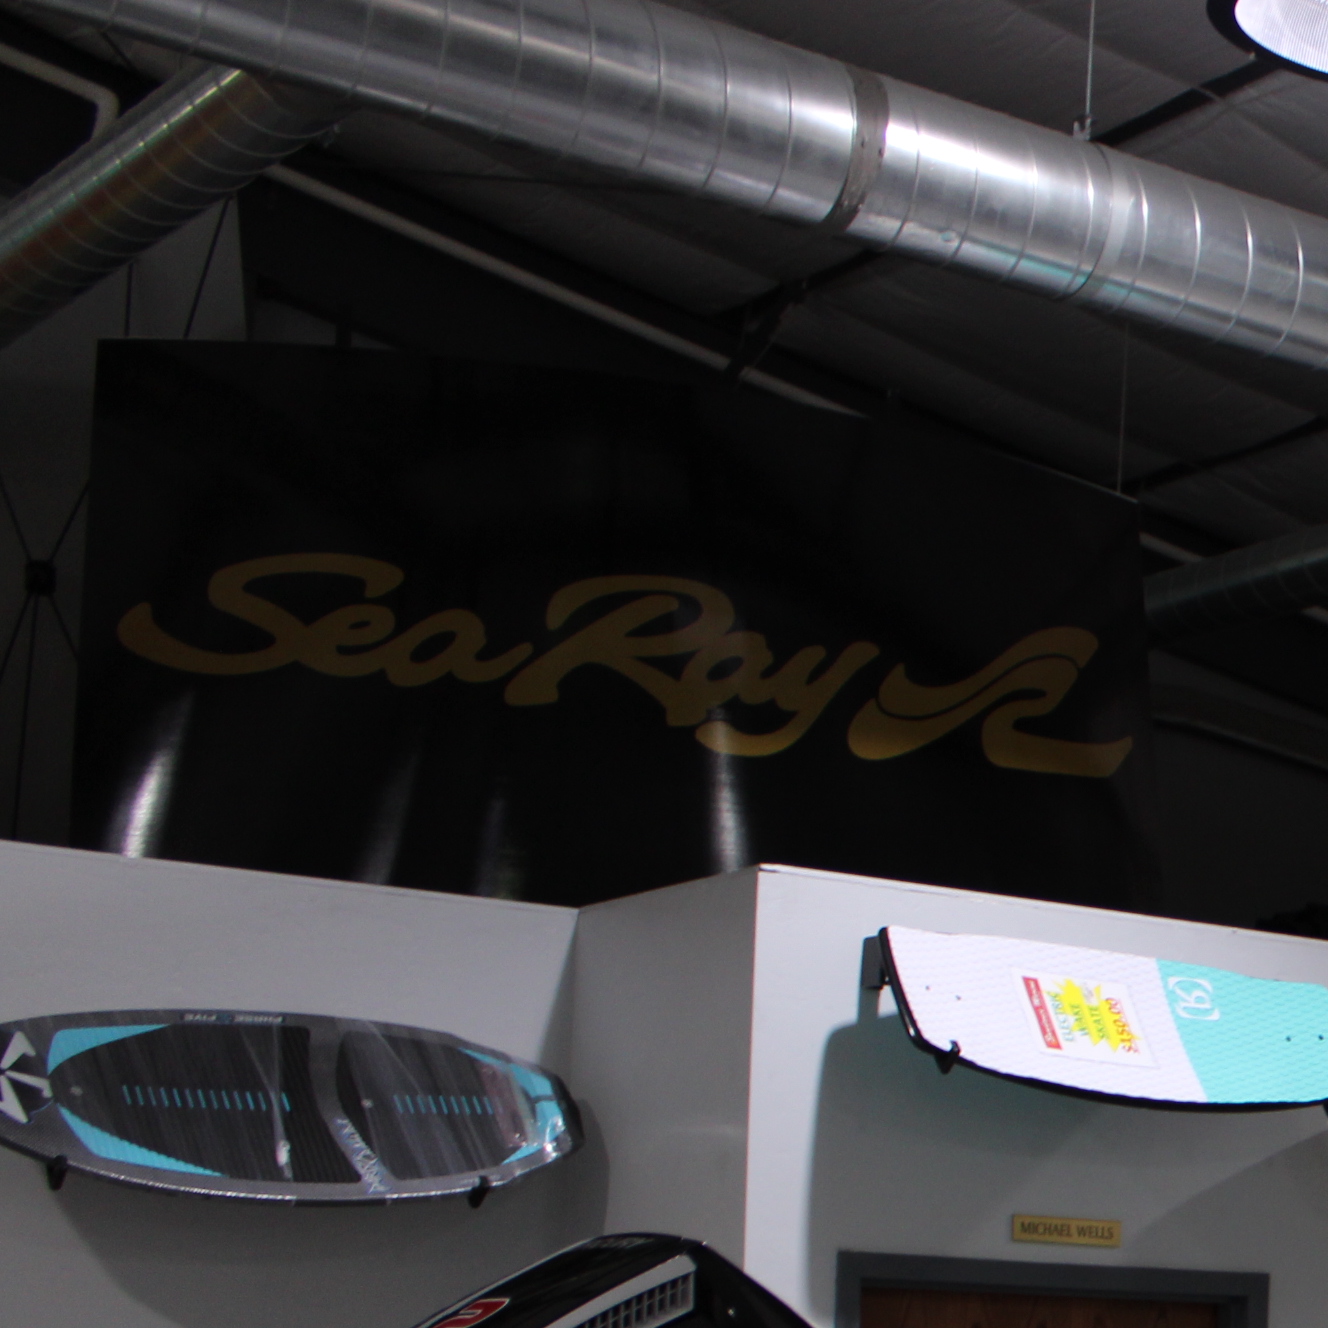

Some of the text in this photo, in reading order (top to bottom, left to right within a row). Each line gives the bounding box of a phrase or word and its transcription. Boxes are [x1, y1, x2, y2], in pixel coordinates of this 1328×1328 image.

[116, 551, 879, 758] Sea Ray
[1020, 1221, 1114, 1240] MICHAEL WELLS
